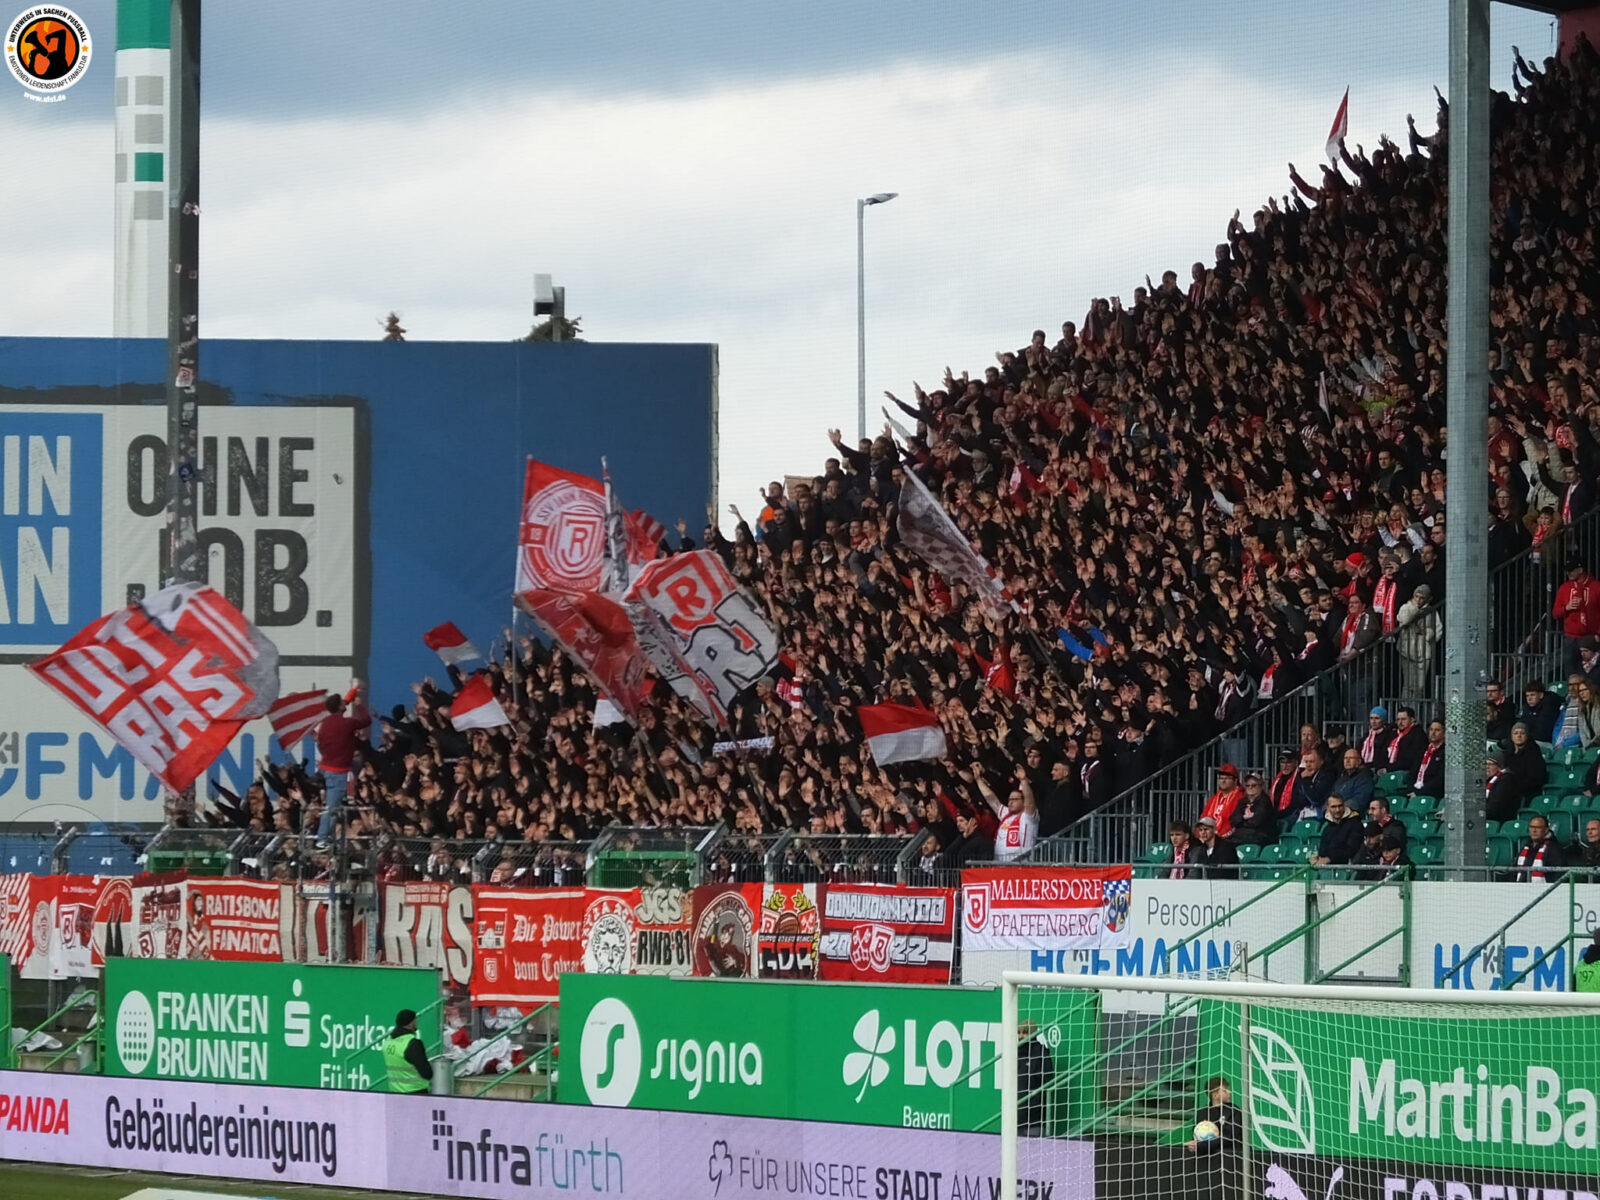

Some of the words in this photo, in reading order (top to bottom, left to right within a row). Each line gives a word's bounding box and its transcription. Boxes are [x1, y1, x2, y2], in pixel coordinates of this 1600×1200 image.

[634, 887, 682, 924] JGS
[992, 879, 1102, 901] MALLERSDORF
[512, 914, 538, 942] Die
[541, 914, 582, 948] Power
[992, 912, 1100, 937] PFAFFENBERG
[1148, 896, 1232, 928] Personal
[826, 932, 852, 960] 20
[892, 936, 928, 965] 22
[513, 956, 538, 981] vom
[157, 991, 268, 1034] FRANKEN
[156, 1035, 268, 1081] BRUNNEN
[650, 1039, 762, 1100] signia
[0, 1095, 70, 1136] PANDA
[1350, 1058, 1598, 1150] MartinBa
[106, 1096, 336, 1178] Gebäudereinigung
[740, 1150, 778, 1192] FÜR
[786, 1160, 867, 1200] UNSERE
[875, 1168, 942, 1200] STADT
[952, 1174, 981, 1200] AM
